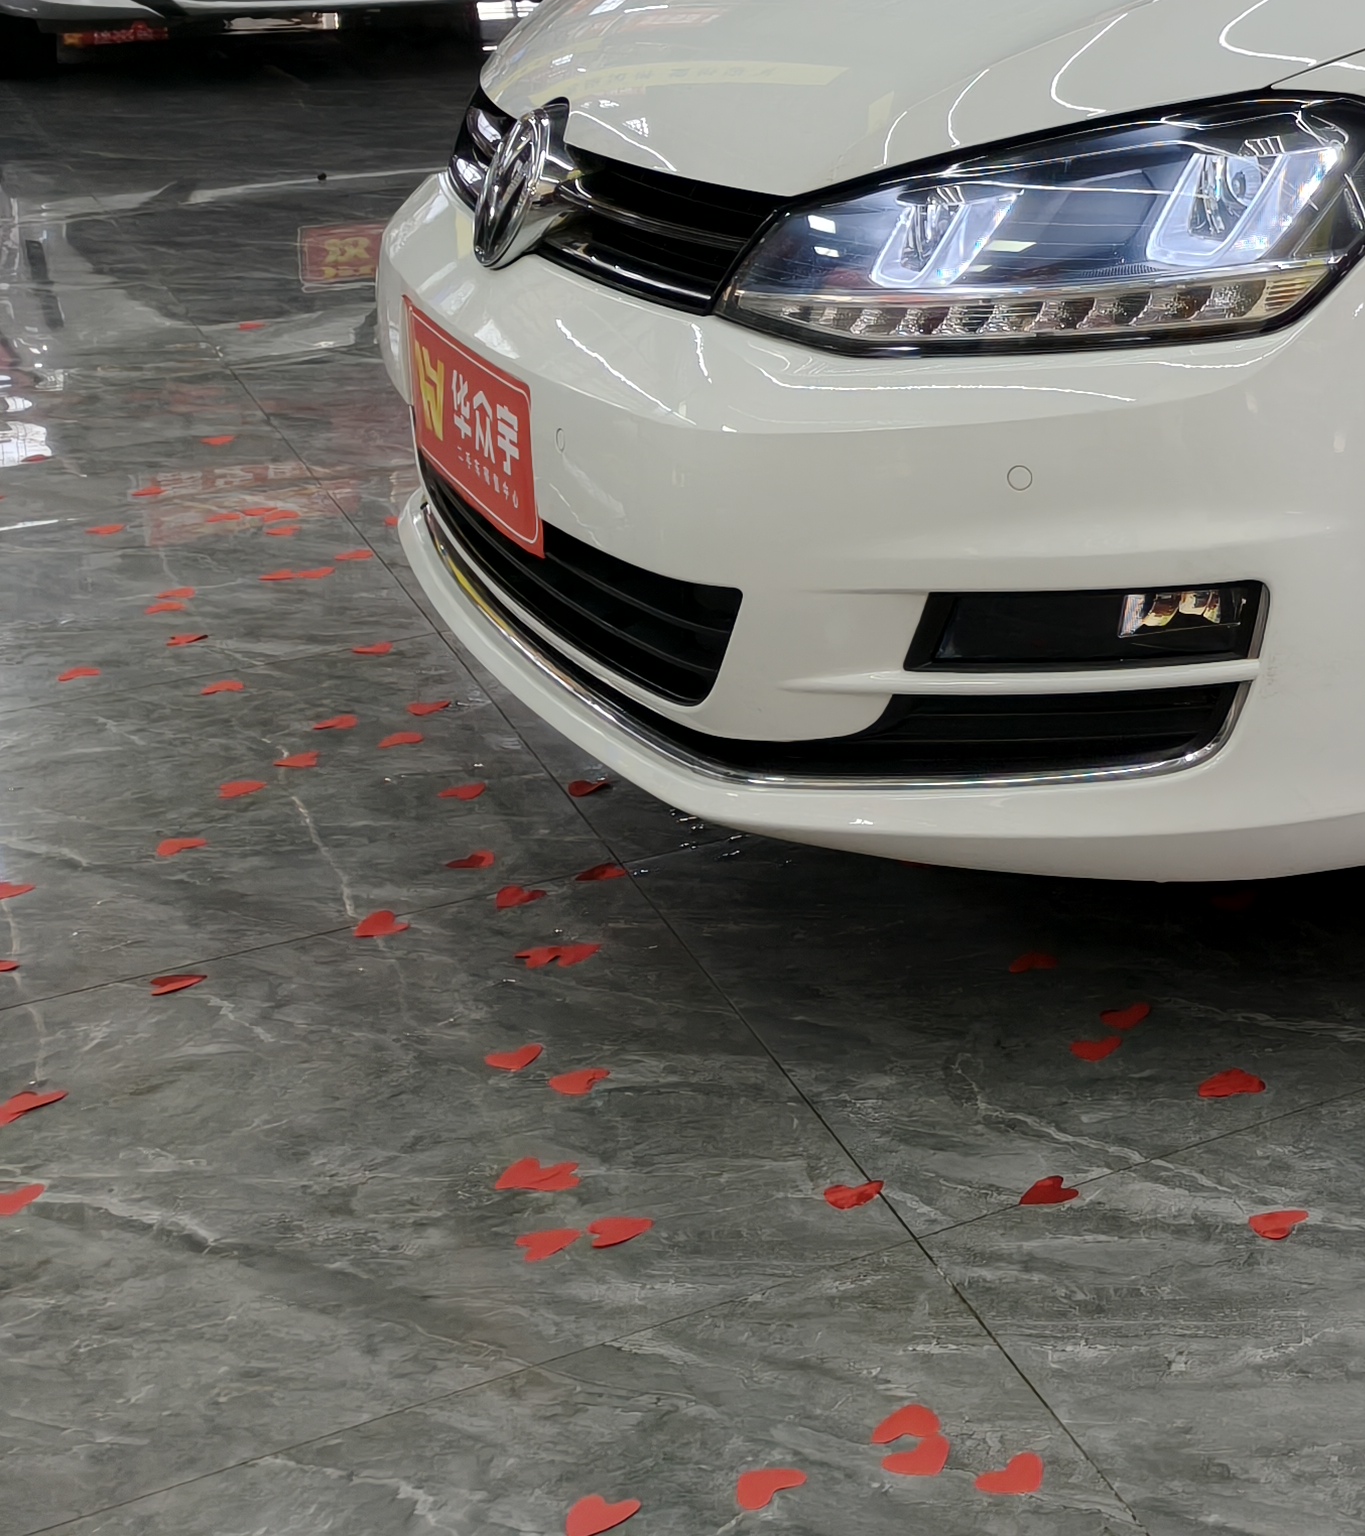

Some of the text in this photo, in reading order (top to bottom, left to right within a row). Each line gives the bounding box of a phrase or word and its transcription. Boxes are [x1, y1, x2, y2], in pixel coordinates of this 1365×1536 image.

[452, 369, 520, 476] 华众宇
[457, 445, 520, 510] 二手车销售中心
